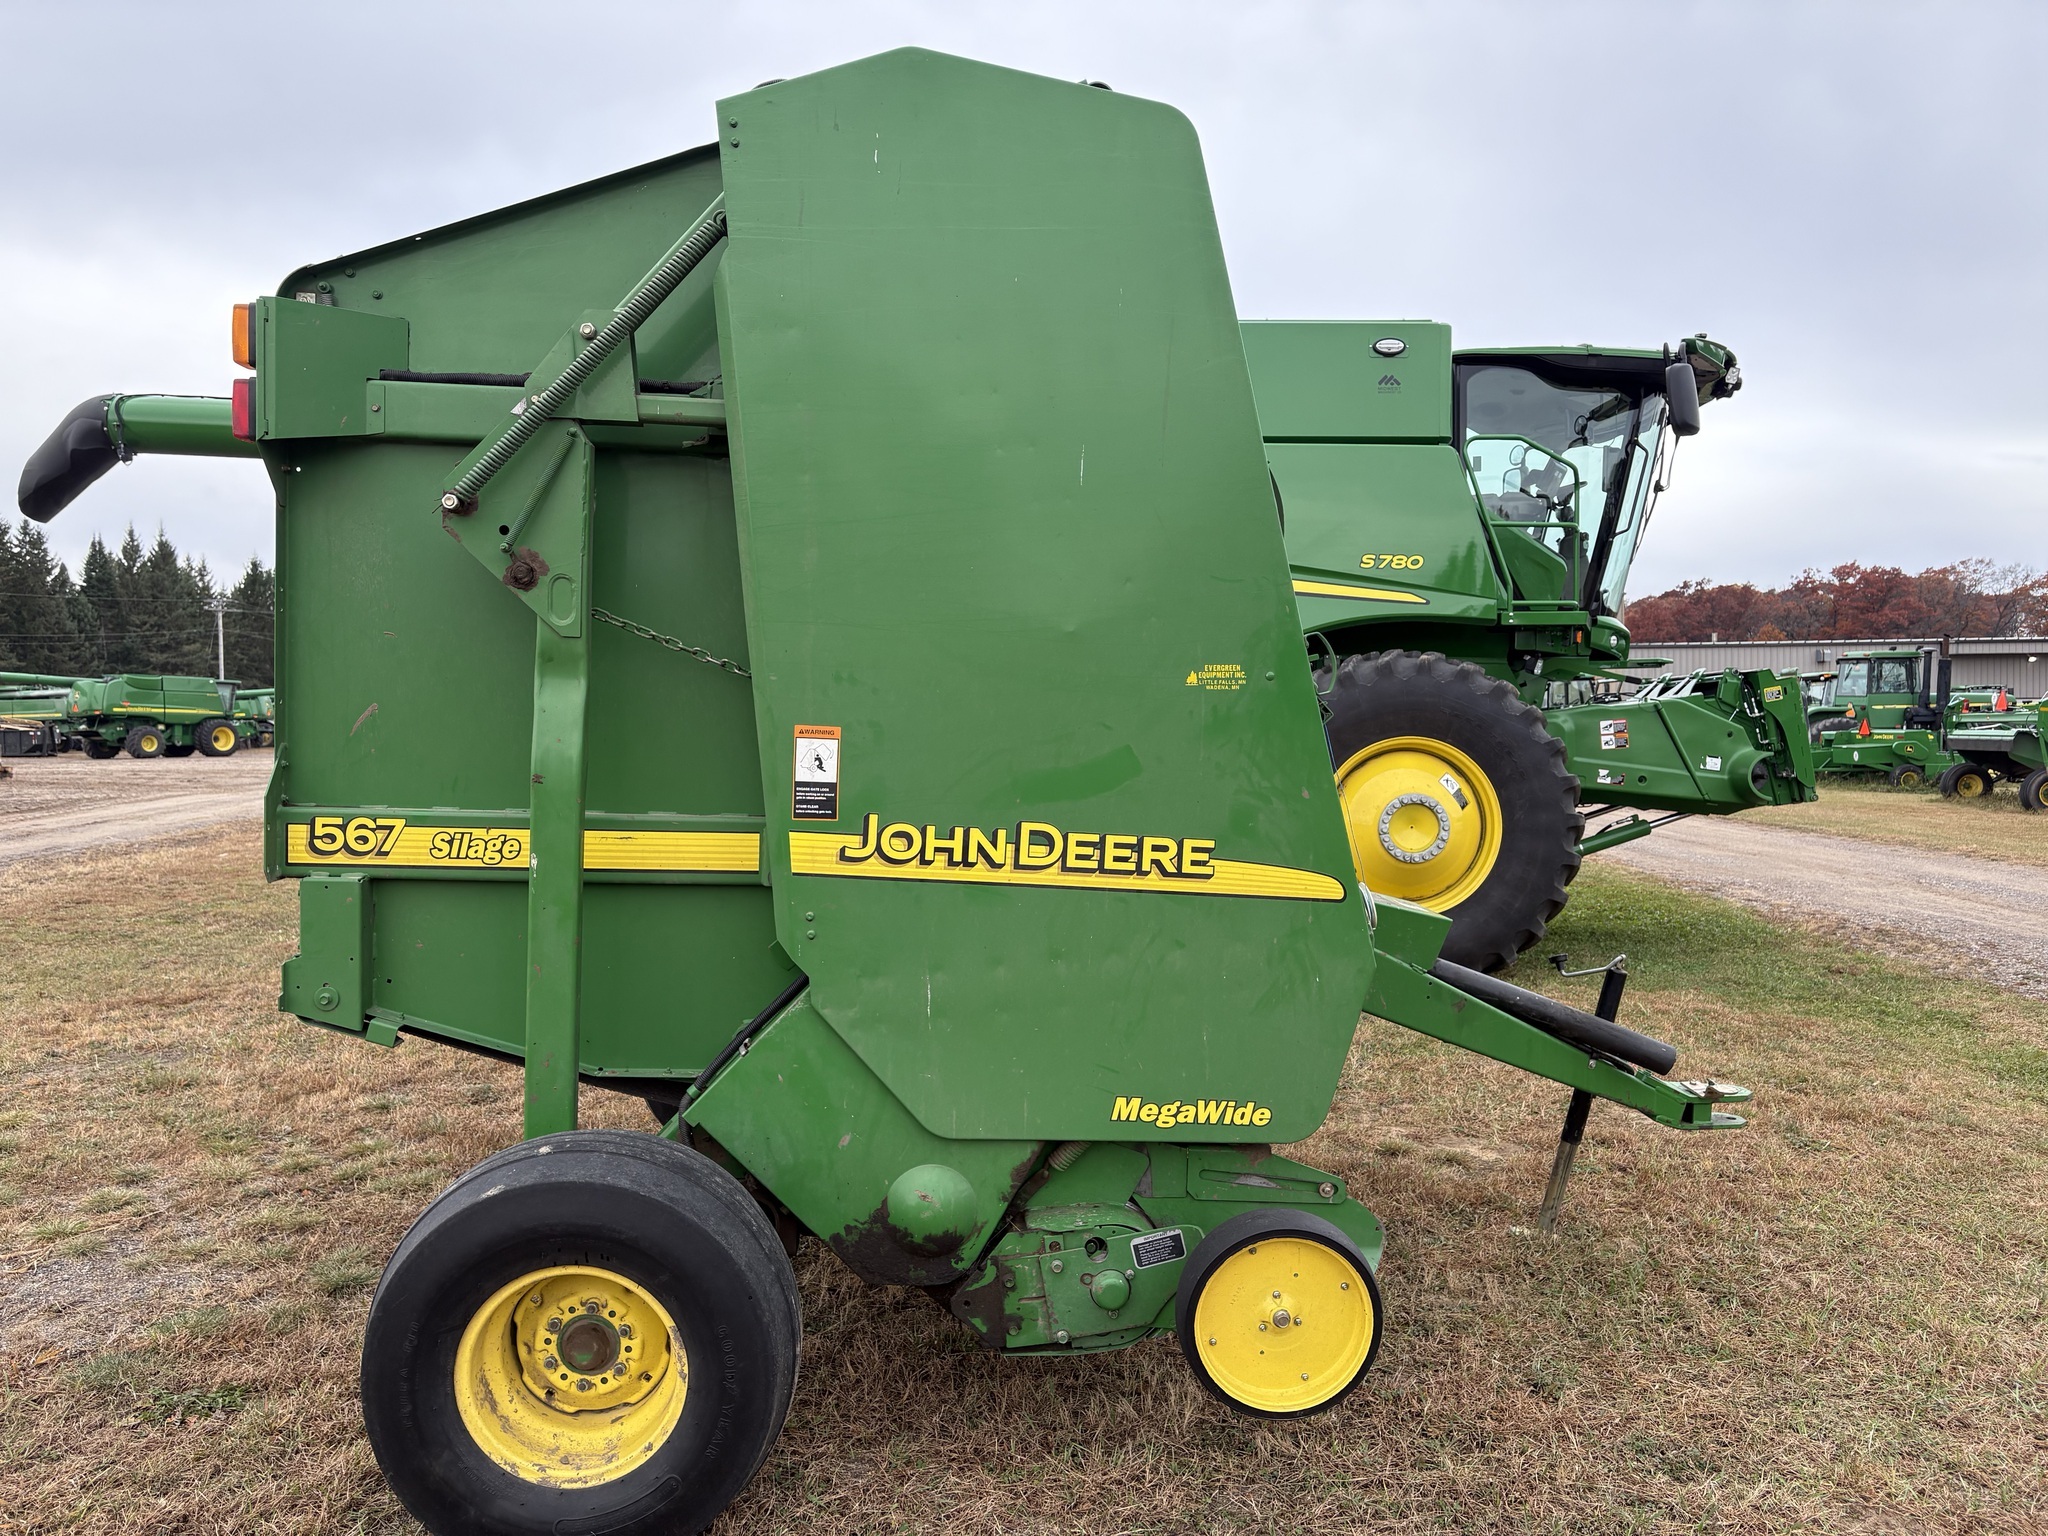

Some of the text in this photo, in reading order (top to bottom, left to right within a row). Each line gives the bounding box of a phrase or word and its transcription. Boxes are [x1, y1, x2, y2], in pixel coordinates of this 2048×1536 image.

[1359, 553, 1425, 571] S780
[1198, 671, 1234, 679] EQUIPMENT
[309, 816, 521, 865] 567 Silage
[840, 811, 1217, 880] JOHN DEERE
[1110, 1096, 1273, 1129] MegaWide
